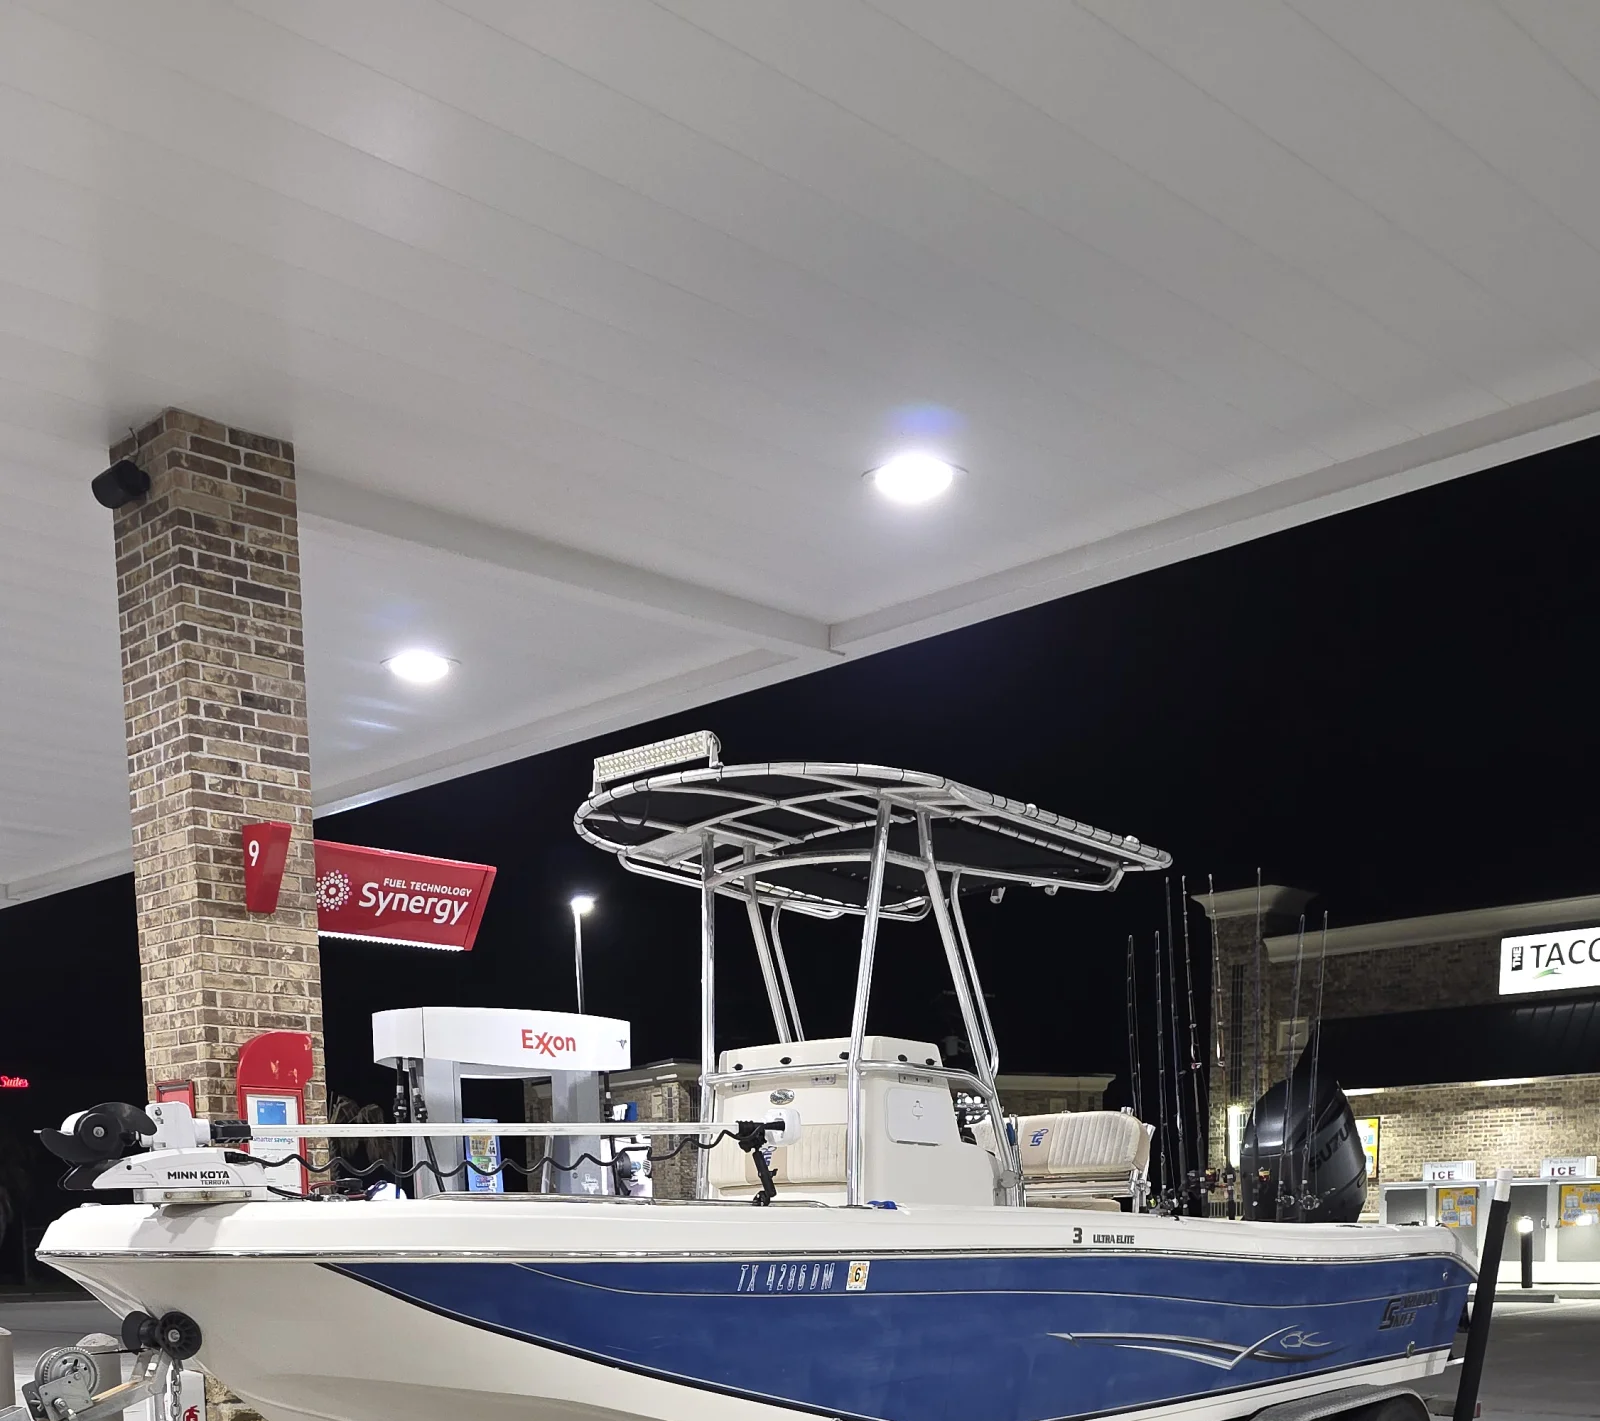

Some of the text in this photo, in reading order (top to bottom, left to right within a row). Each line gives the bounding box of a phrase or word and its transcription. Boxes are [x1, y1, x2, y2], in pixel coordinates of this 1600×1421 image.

[249, 840, 260, 867] 9
[383, 877, 472, 897] FUEL TECHNOLOGY
[359, 882, 469, 925] Synergy
[1511, 946, 1523, 971] THE
[521, 1029, 576, 1058] Exxon
[0, 1075, 28, 1087] Suites
[167, 1170, 230, 1180] MINN KOTA
[1432, 1171, 1455, 1180] ICE
[1551, 1166, 1576, 1176] ICE
[1073, 1227, 1083, 1244] 3
[1093, 1234, 1135, 1244] ULTRA ELITE
[737, 1264, 759, 1291] TX
[854, 1267, 862, 1282] 6
